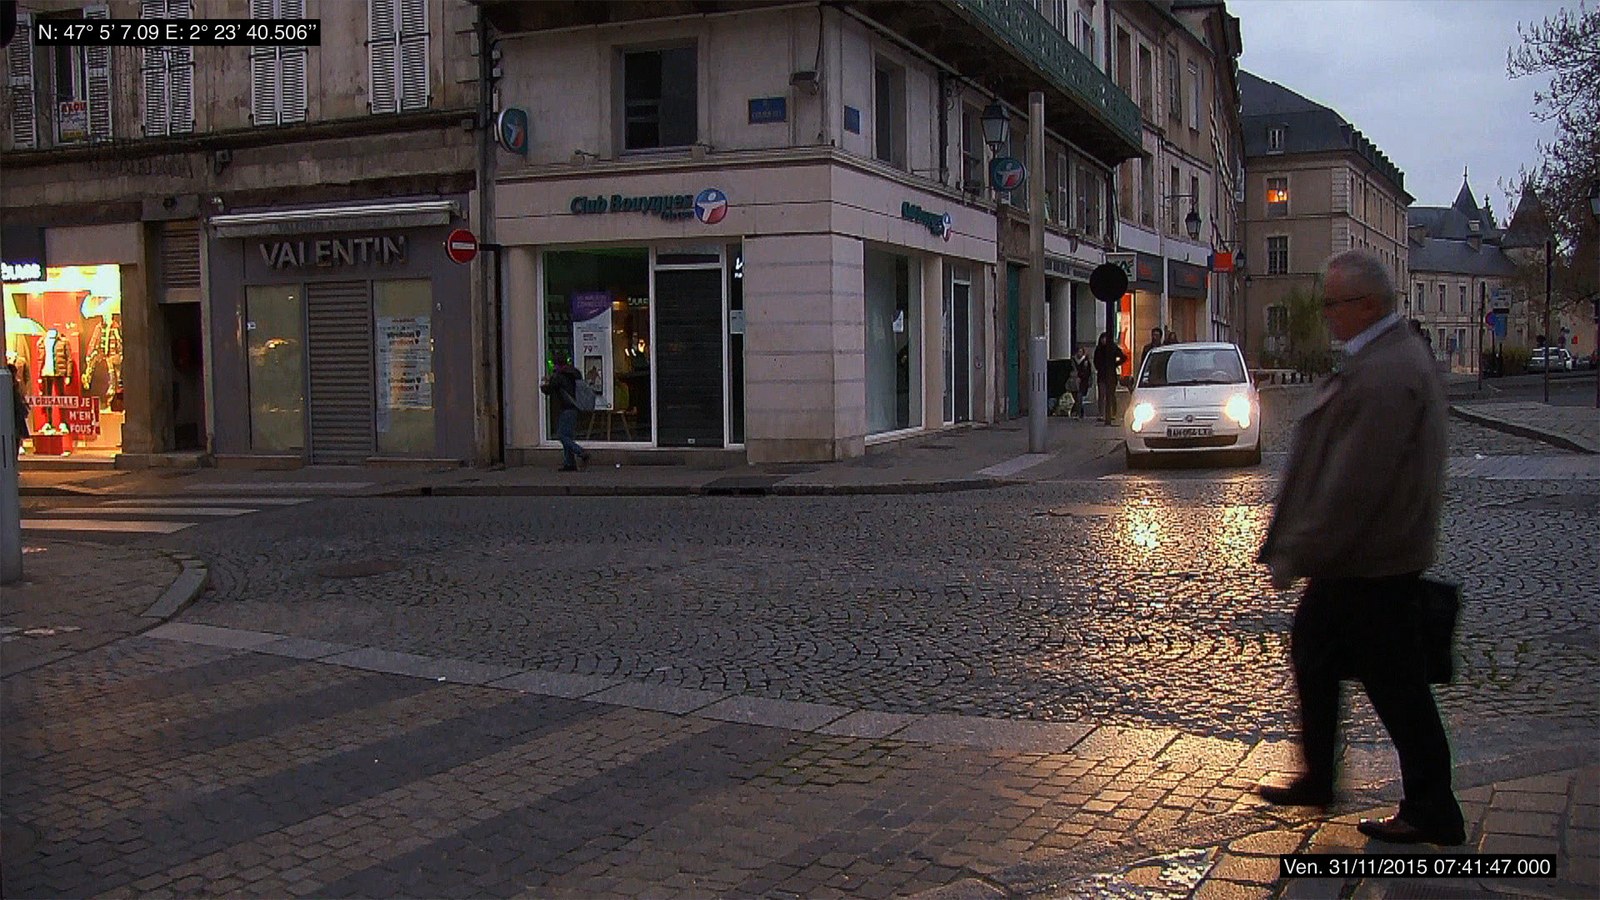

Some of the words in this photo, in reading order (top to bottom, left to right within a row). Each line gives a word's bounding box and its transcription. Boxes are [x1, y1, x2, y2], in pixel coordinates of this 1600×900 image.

[570, 195, 608, 214] Club
[609, 194, 694, 216] Bouygues
[259, 235, 407, 268] VALENTIN
[35, 397, 77, 408] GRISAILLE
[80, 397, 91, 407] JE
